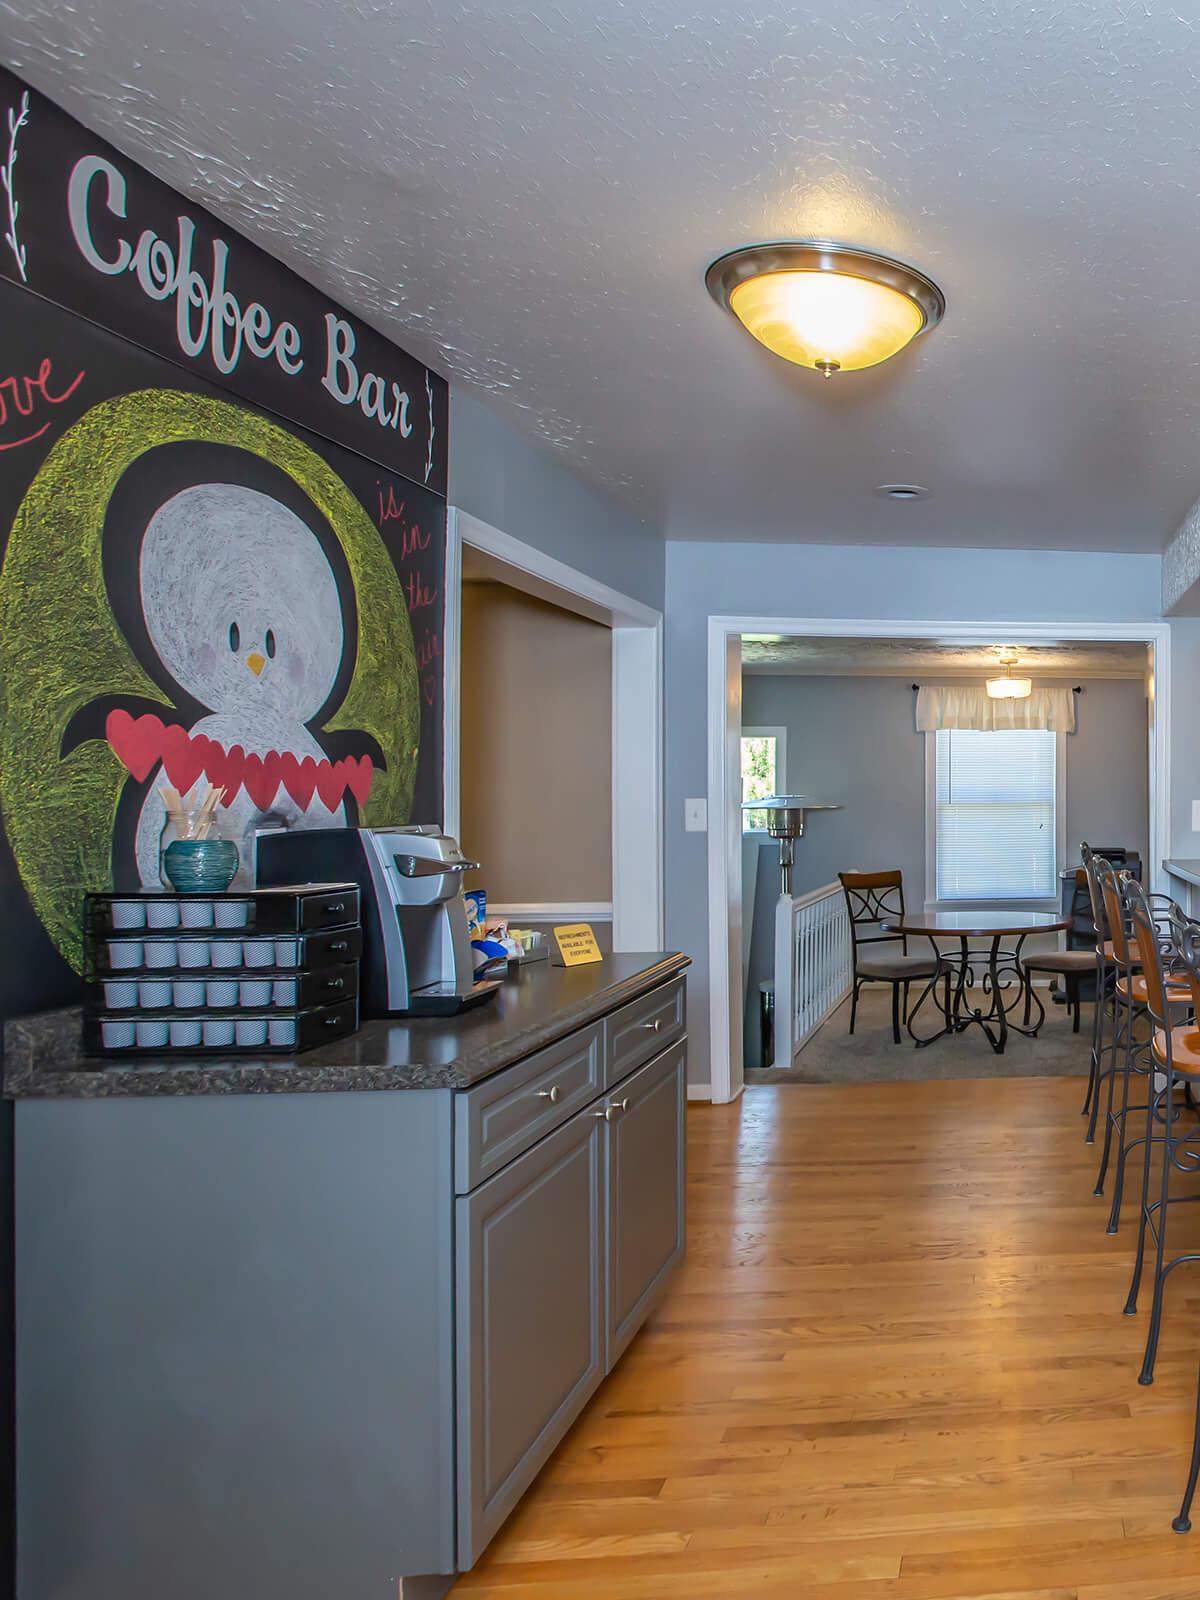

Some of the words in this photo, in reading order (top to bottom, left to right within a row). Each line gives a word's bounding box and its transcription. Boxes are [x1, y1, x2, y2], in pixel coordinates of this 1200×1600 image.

[68, 155, 303, 375] Coffee
[321, 313, 412, 438] Bar
[376, 480, 405, 525] is
[401, 521, 431, 560] in
[407, 572, 437, 609] the
